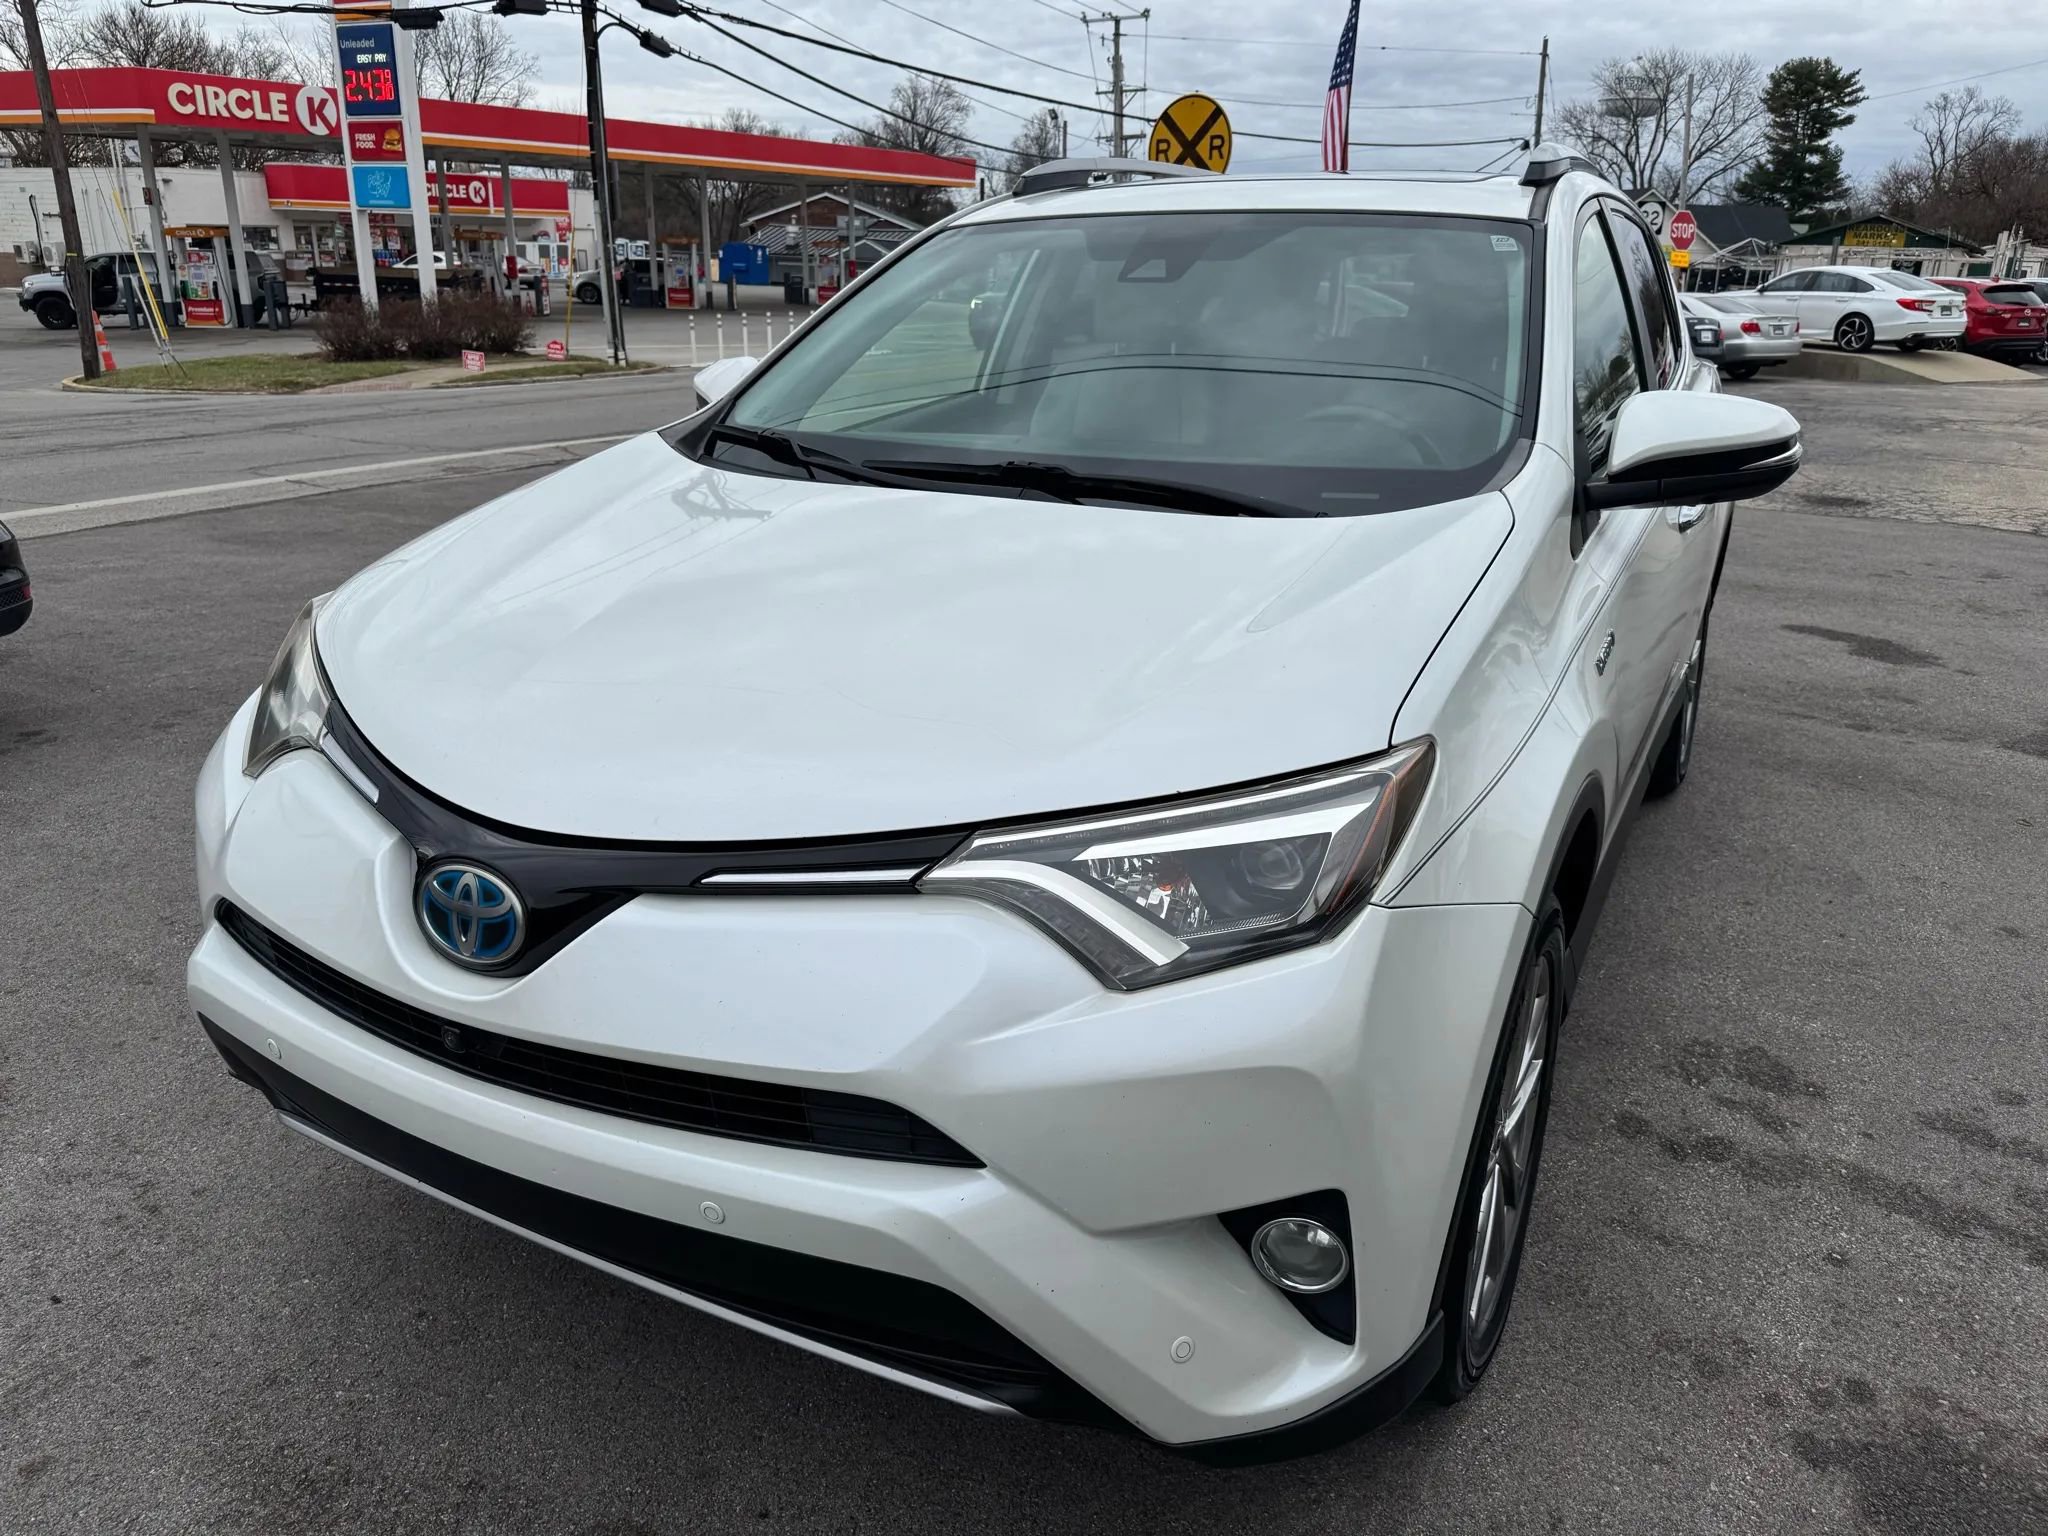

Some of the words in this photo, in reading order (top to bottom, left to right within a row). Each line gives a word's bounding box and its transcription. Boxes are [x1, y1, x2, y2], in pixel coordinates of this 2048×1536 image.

[340, 38, 375, 49] Unleaded
[356, 54, 372, 64] EASY
[374, 53, 387, 63] PAY
[167, 82, 290, 123] CIRCLE
[303, 93, 337, 134] K
[354, 133, 376, 142] FRESH
[426, 183, 467, 199] CICLE
[472, 183, 486, 202] K
[1671, 222, 1695, 239] STOP
